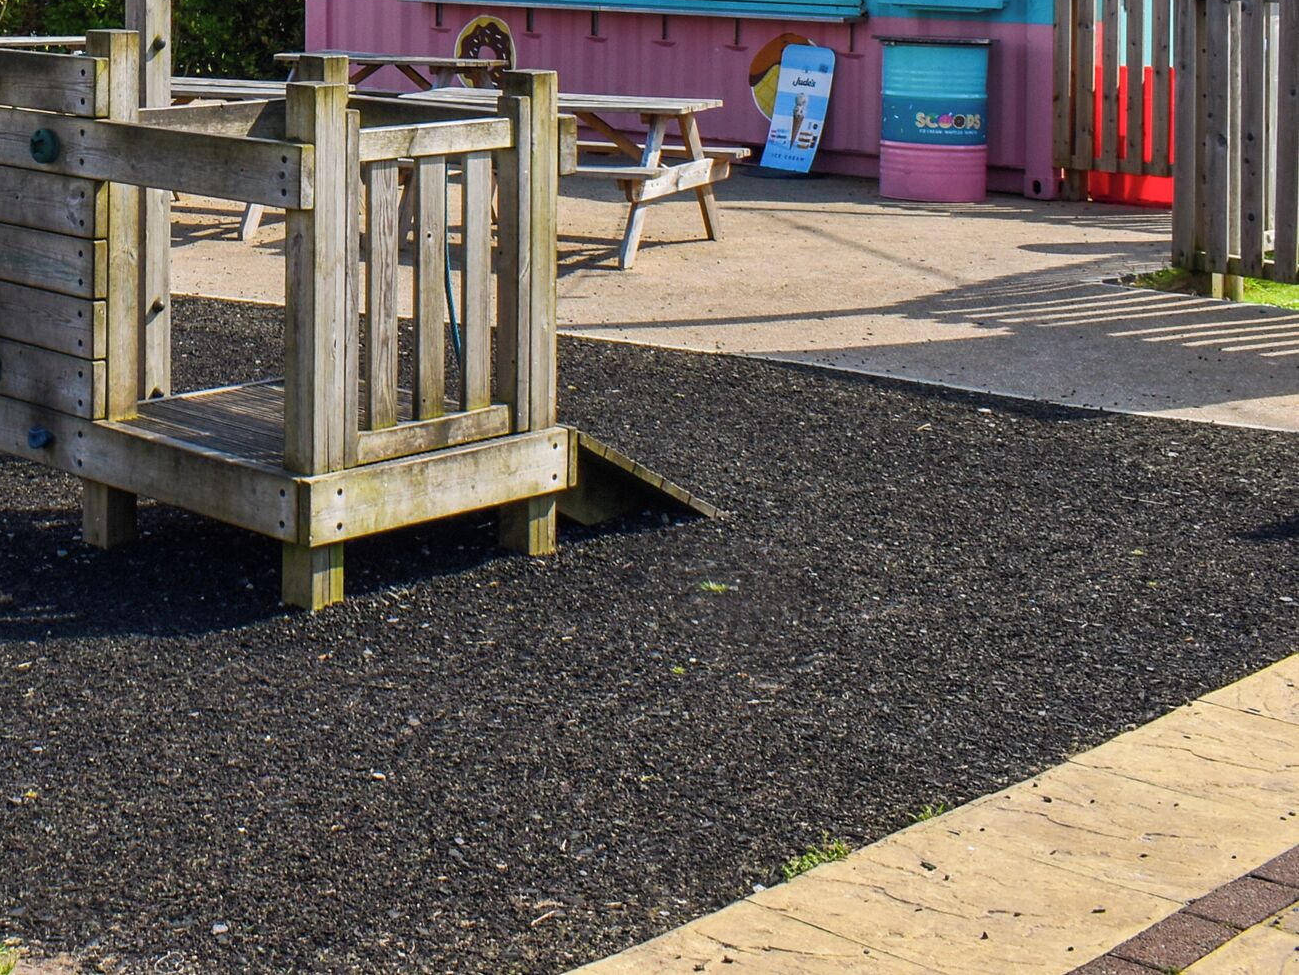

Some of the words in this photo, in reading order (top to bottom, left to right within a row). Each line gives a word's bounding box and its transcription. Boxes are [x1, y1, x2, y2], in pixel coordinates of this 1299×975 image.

[792, 77, 816, 88] Jude's
[915, 112, 981, 130] SCOOPS
[784, 154, 805, 162] CREAM
